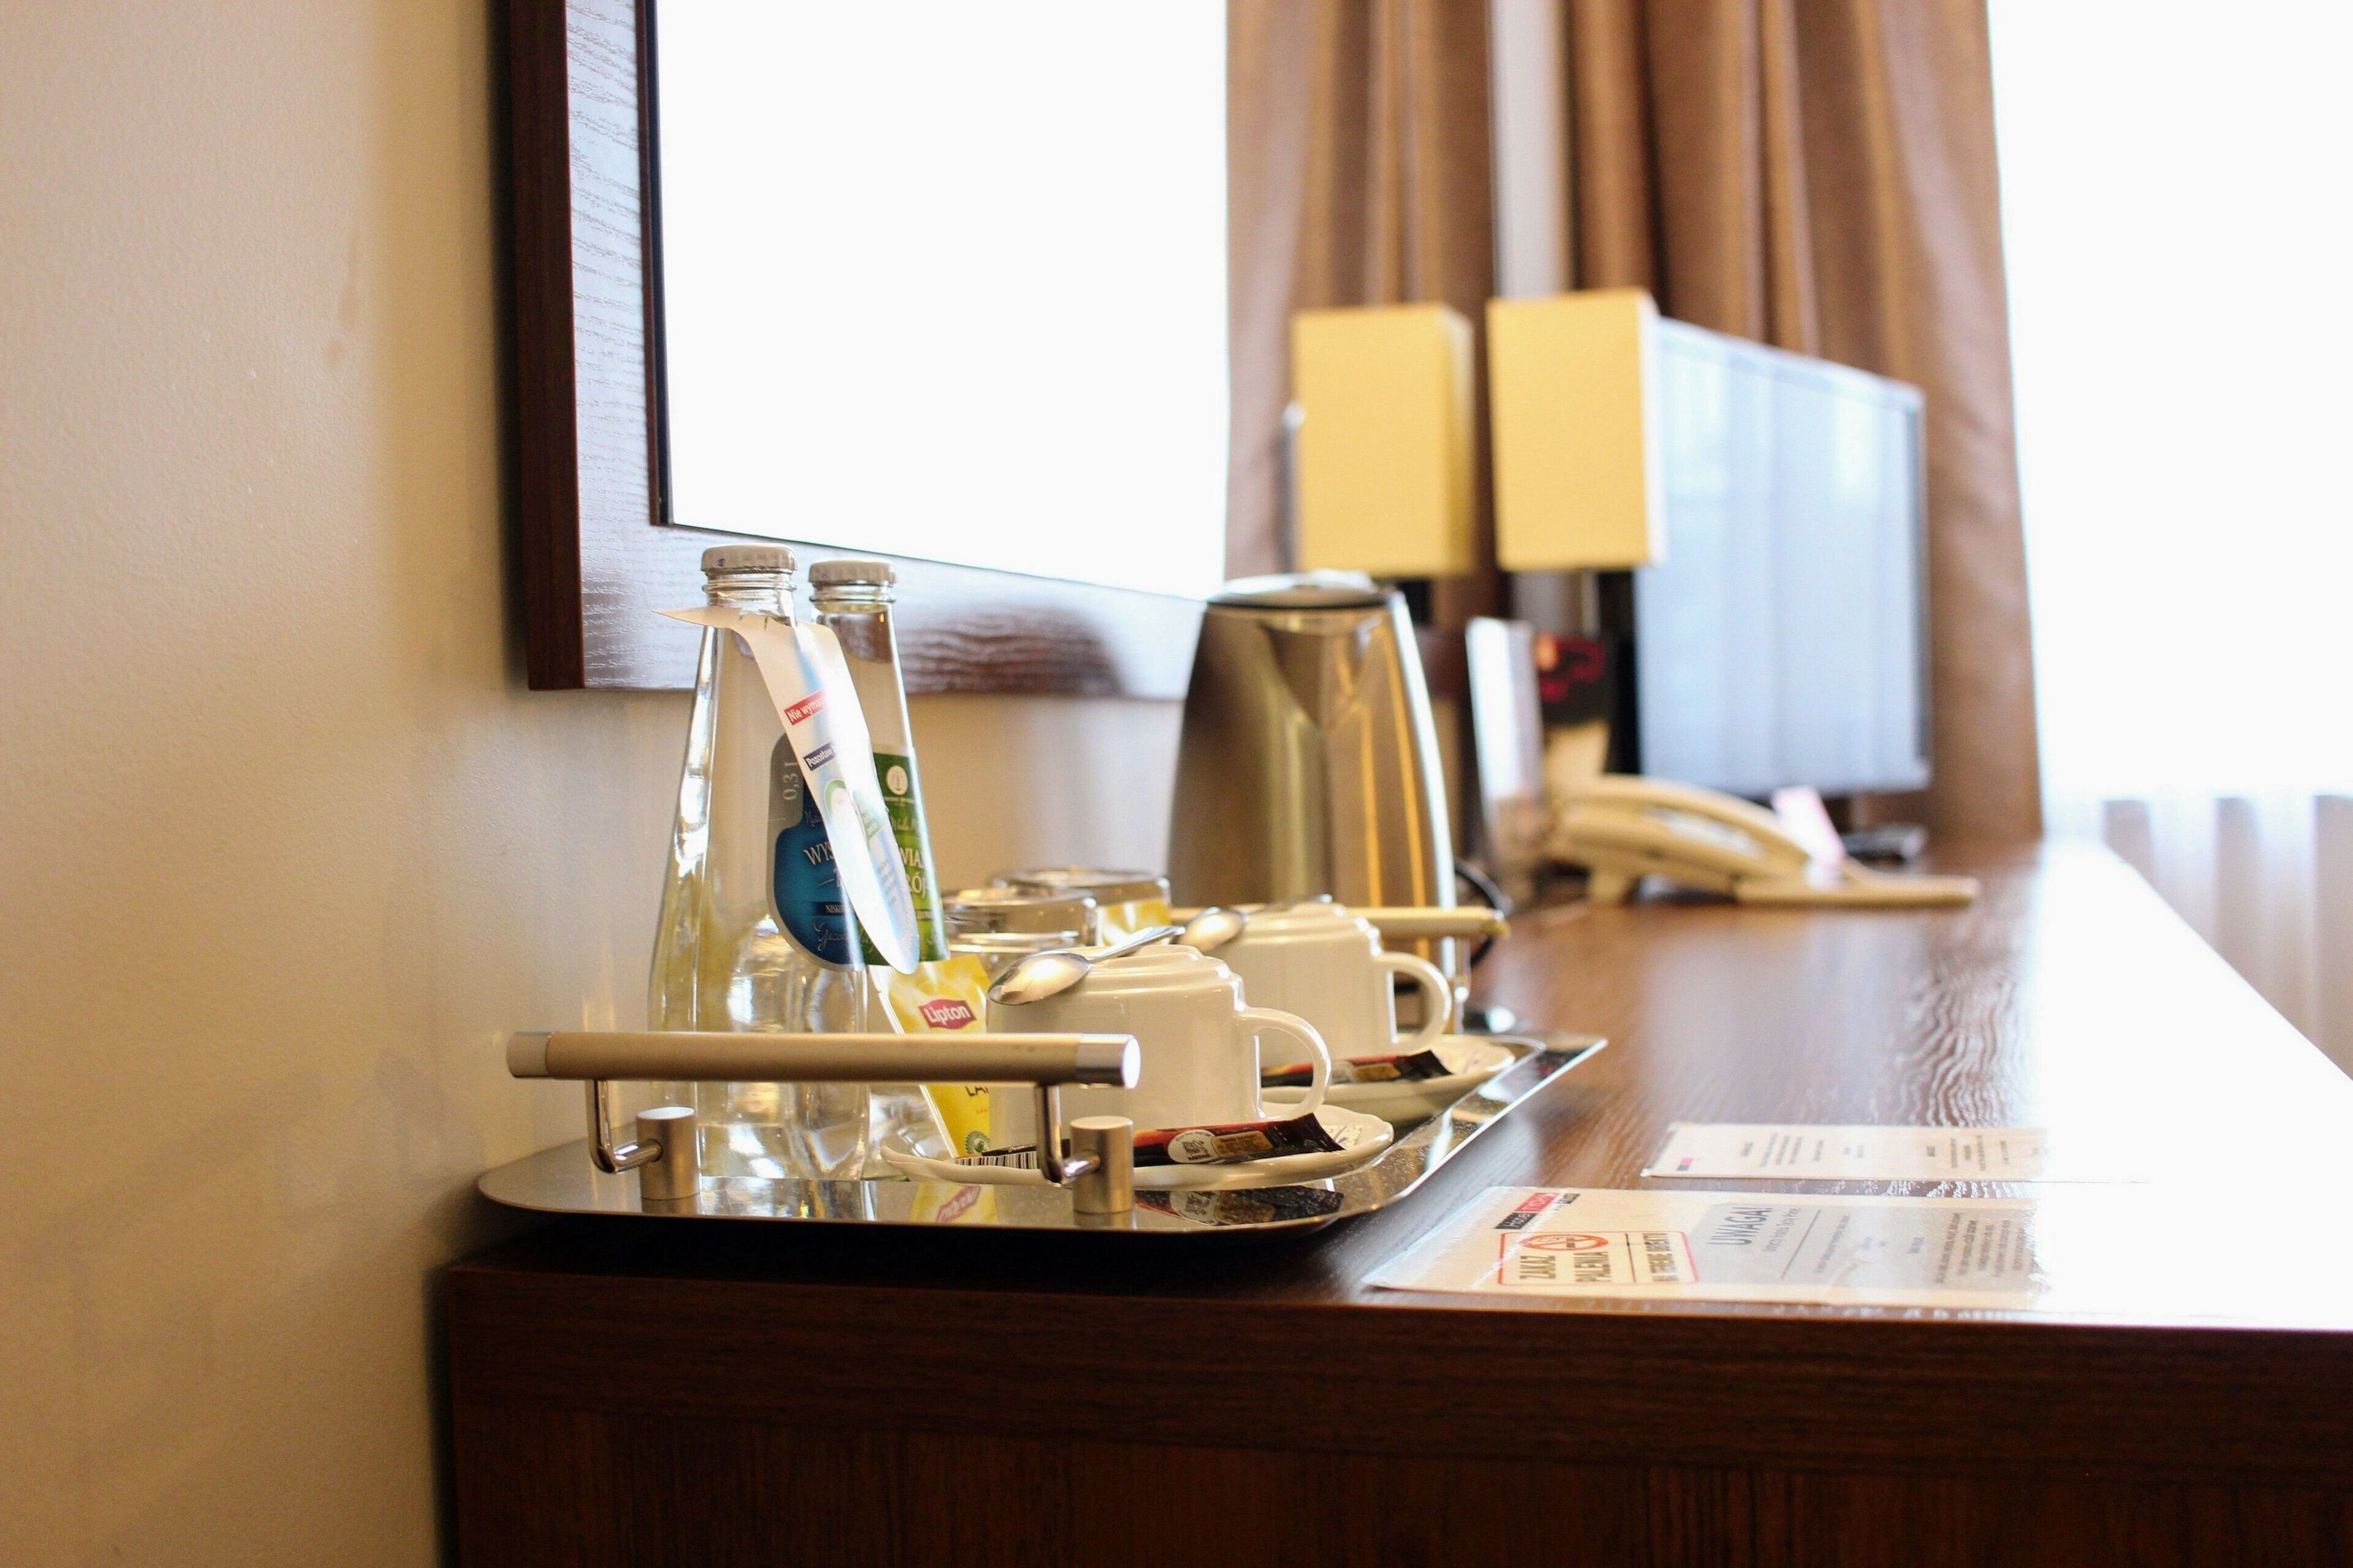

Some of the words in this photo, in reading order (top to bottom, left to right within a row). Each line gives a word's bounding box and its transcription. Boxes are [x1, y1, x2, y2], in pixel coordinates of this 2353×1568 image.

[787, 707, 802, 722] Nie
[805, 747, 833, 767] Pozostaw
[783, 773, 800, 800] 0,3
[924, 1006, 971, 1025] Lipton
[1707, 1206, 1773, 1245] UWAGA!
[1519, 1256, 1556, 1279] ZAKAZ
[1573, 1251, 1611, 1282] PALENIA
